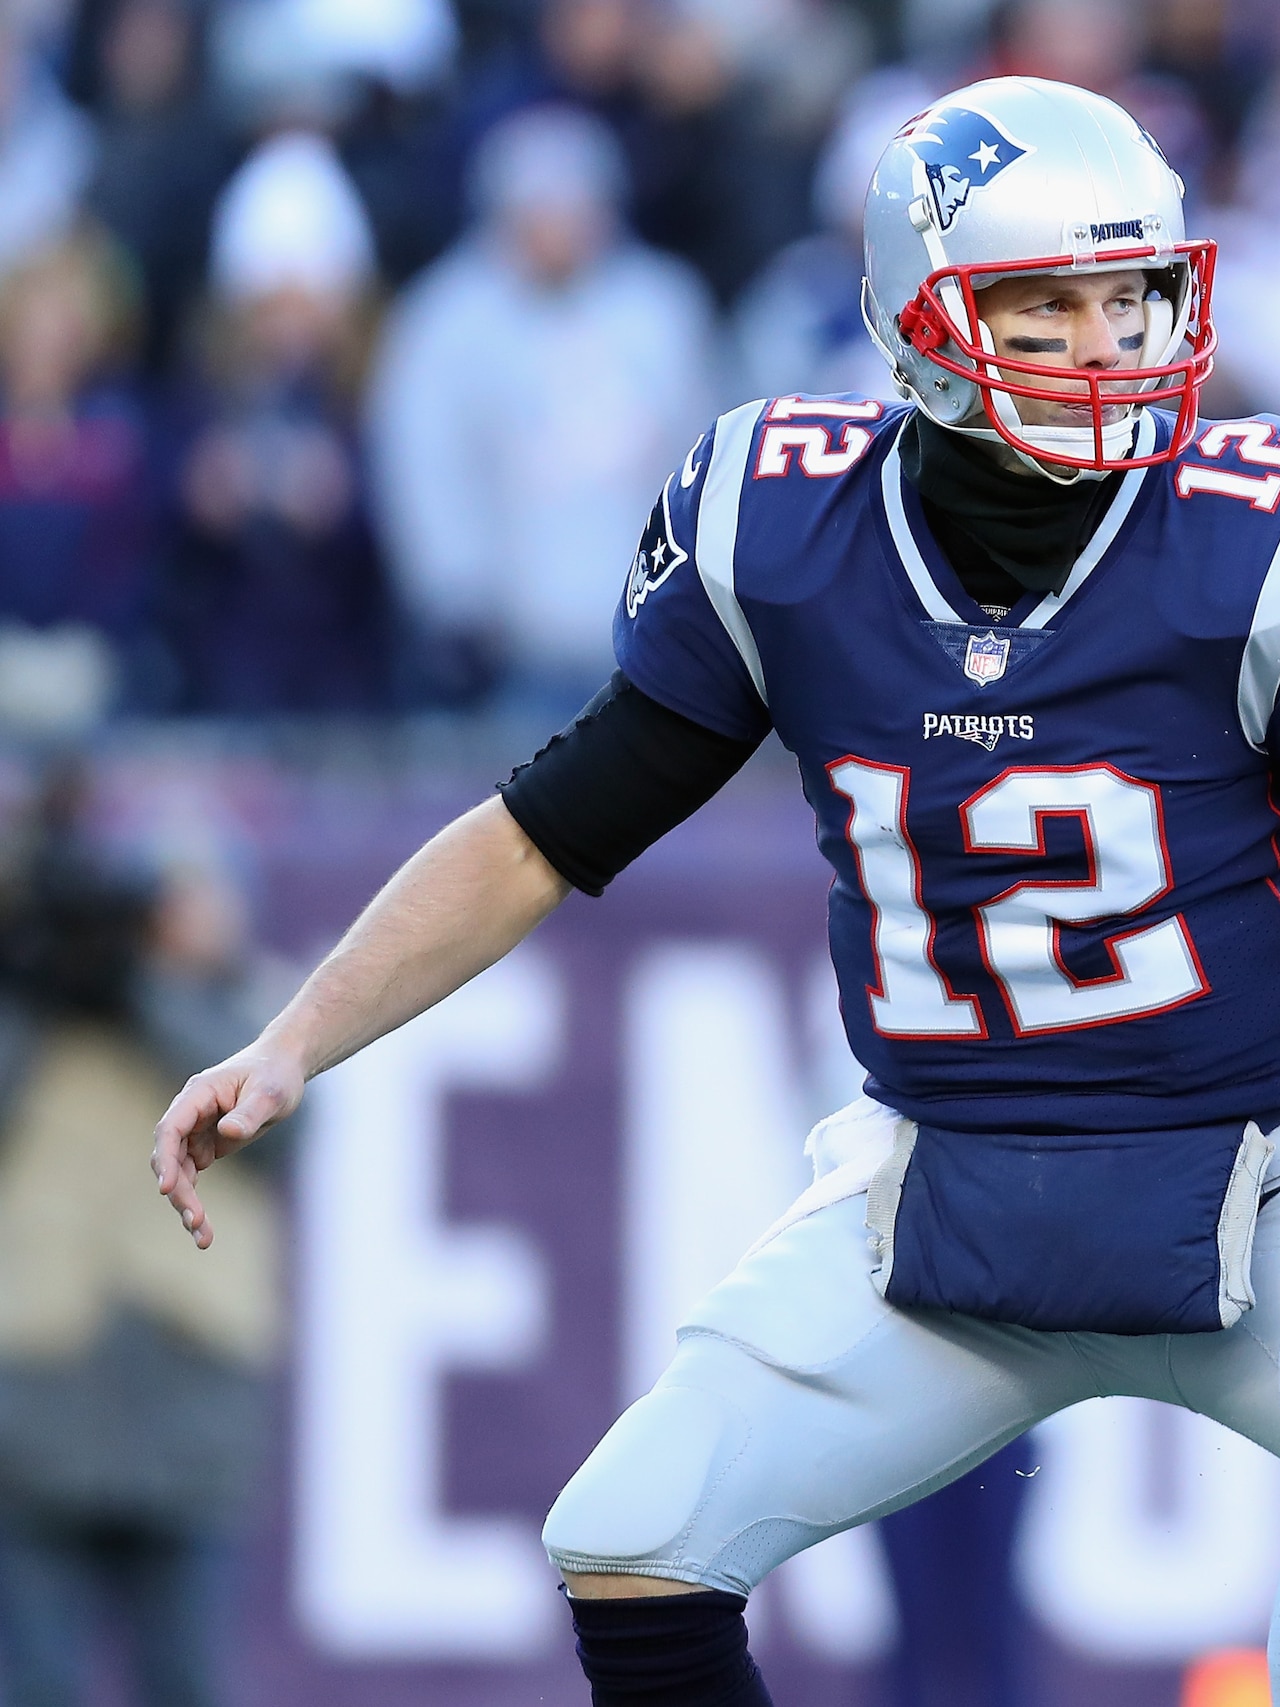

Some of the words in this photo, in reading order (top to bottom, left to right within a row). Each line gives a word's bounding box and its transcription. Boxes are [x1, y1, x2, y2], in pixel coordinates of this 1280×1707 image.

[1090, 219, 1144, 244] PATRIOTS
[753, 397, 885, 480] 12
[923, 712, 1034, 741] PATRIOTS
[825, 754, 1212, 1041] 12
